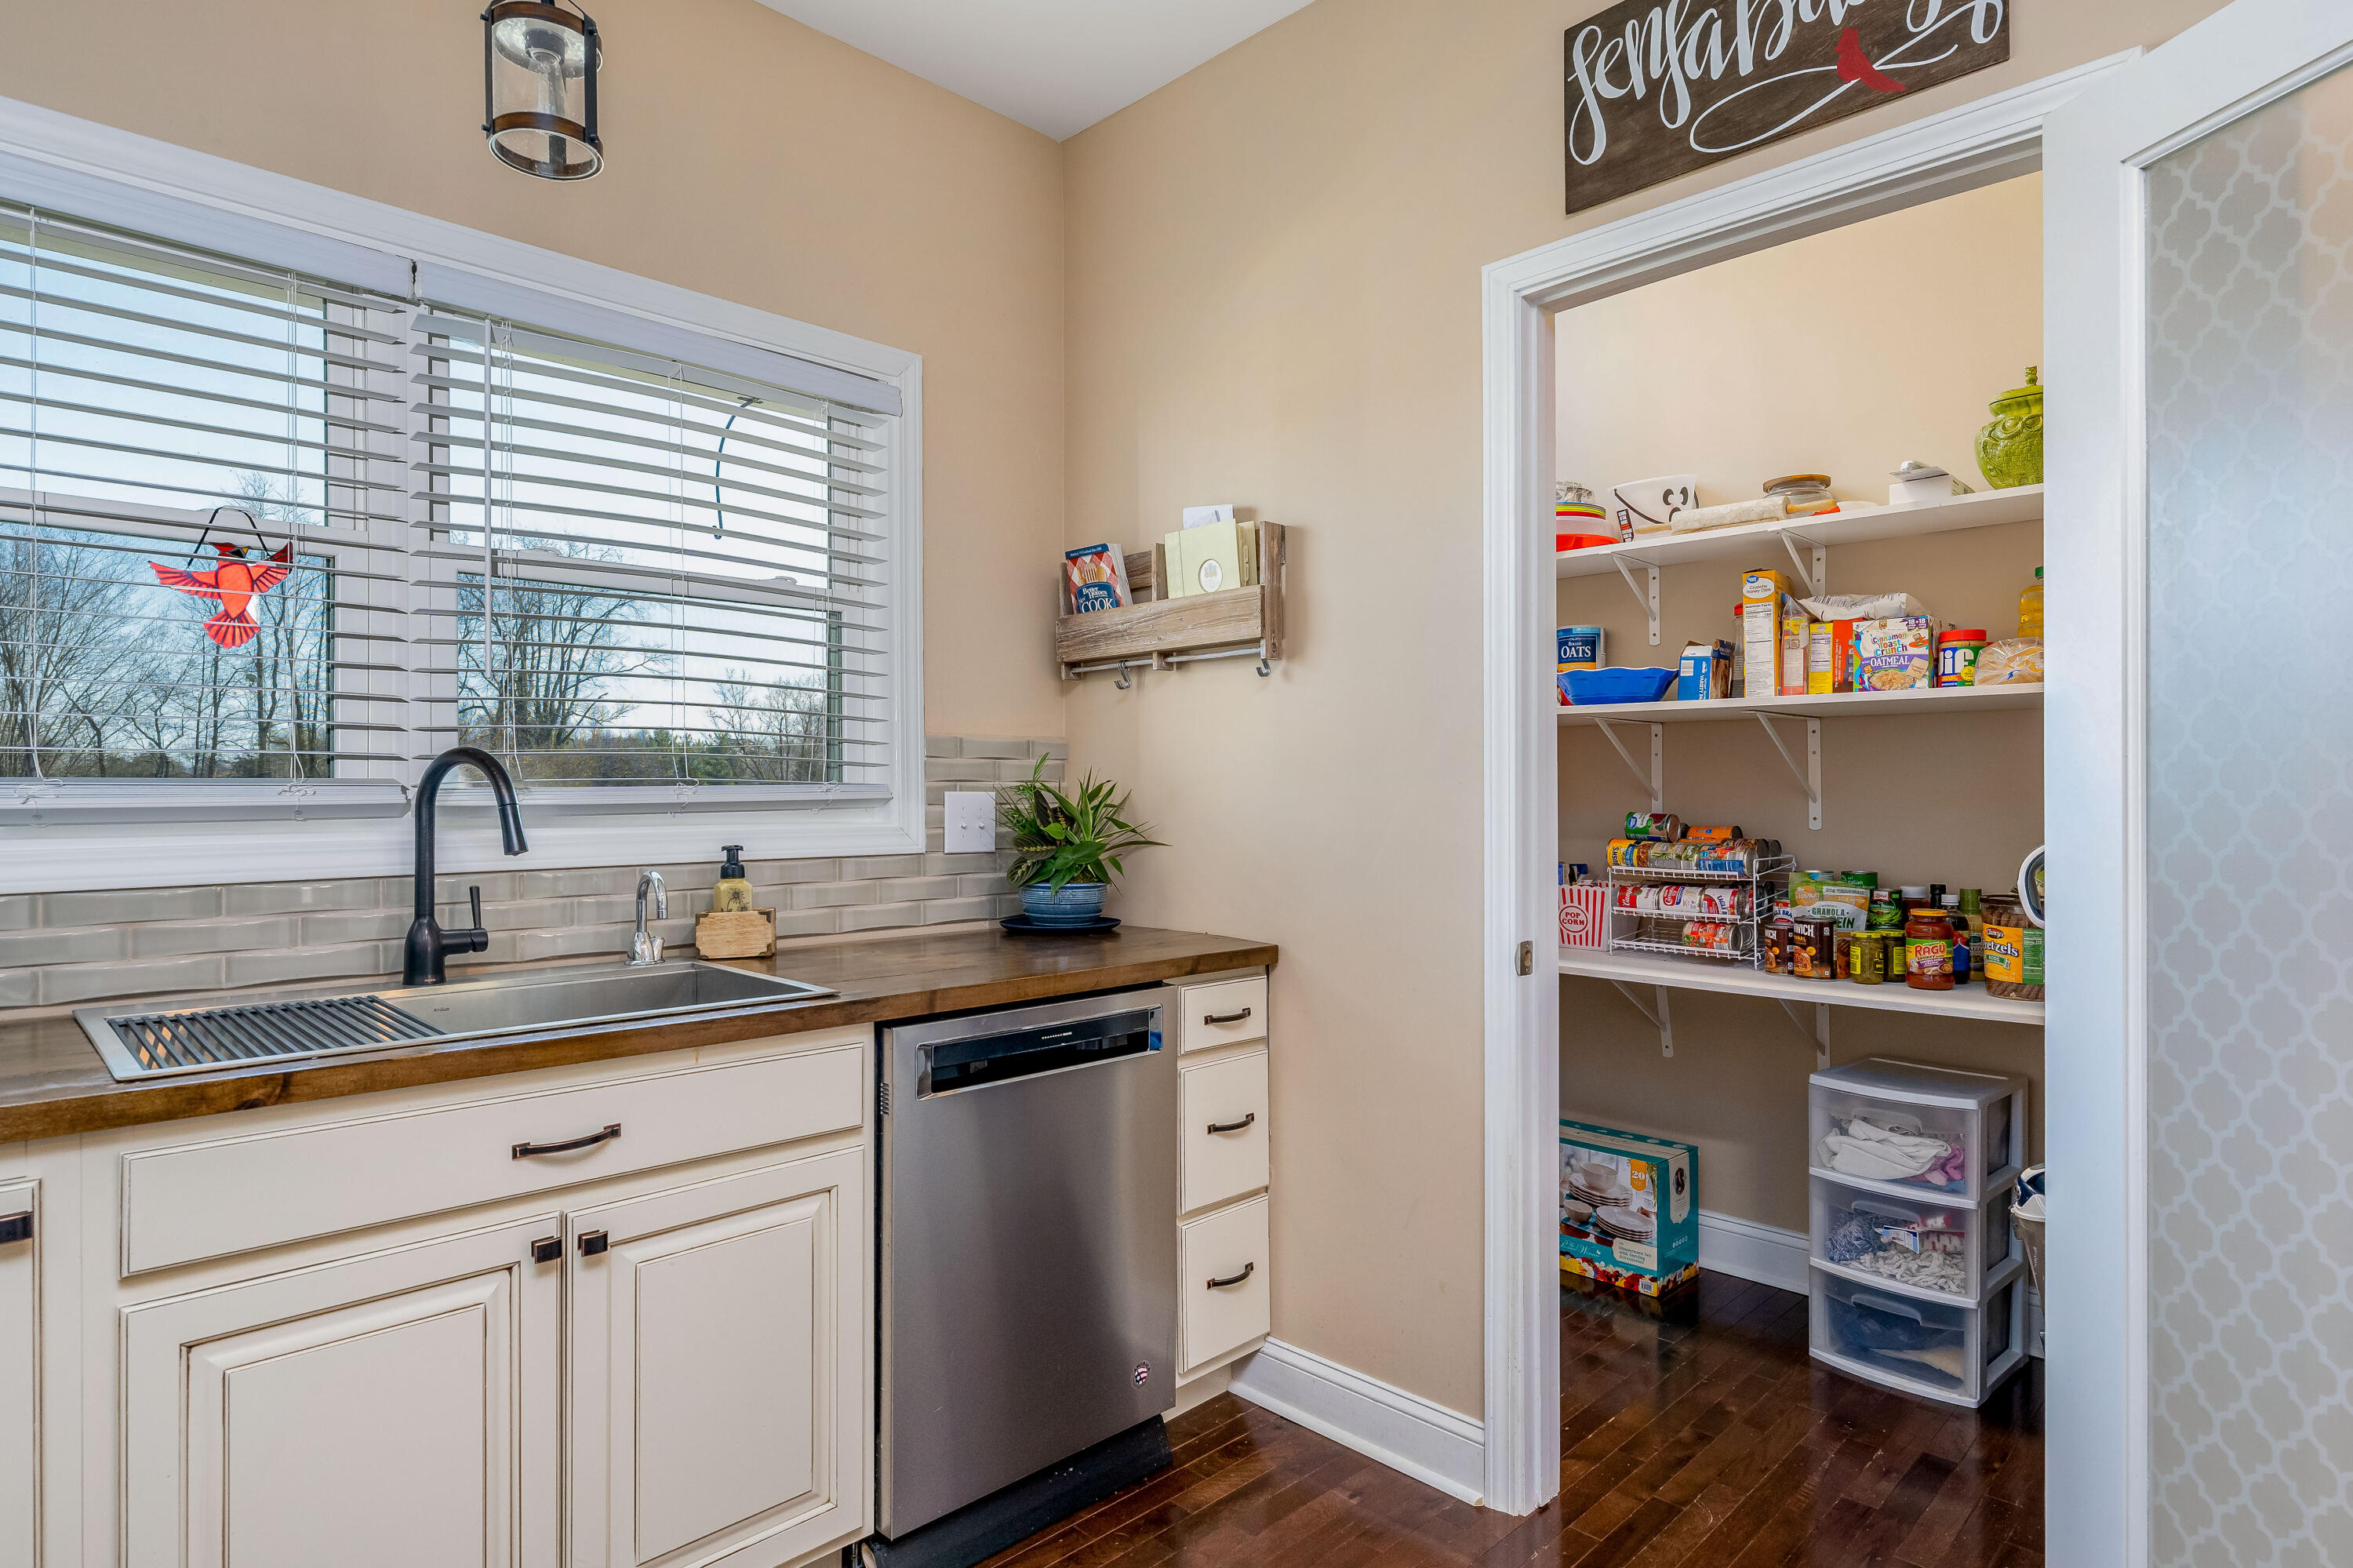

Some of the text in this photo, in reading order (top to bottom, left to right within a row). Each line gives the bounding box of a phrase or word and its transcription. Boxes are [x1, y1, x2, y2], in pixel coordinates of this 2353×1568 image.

[1089, 590, 1107, 598] Homes
[1082, 598, 1113, 613] COOK
[1873, 633, 1907, 643] Cinnamon
[1880, 639, 1901, 649] Toast
[1561, 646, 1591, 658] OATS
[1875, 644, 1907, 656] Crunch
[1870, 656, 1910, 667] OATMEAL
[1782, 910, 1792, 918] BRA
[1812, 908, 1845, 916] GRANOLA
[1794, 923, 1814, 937] WICH
[1984, 941, 2018, 957] retzels
[1632, 1170, 1645, 1180] 20
